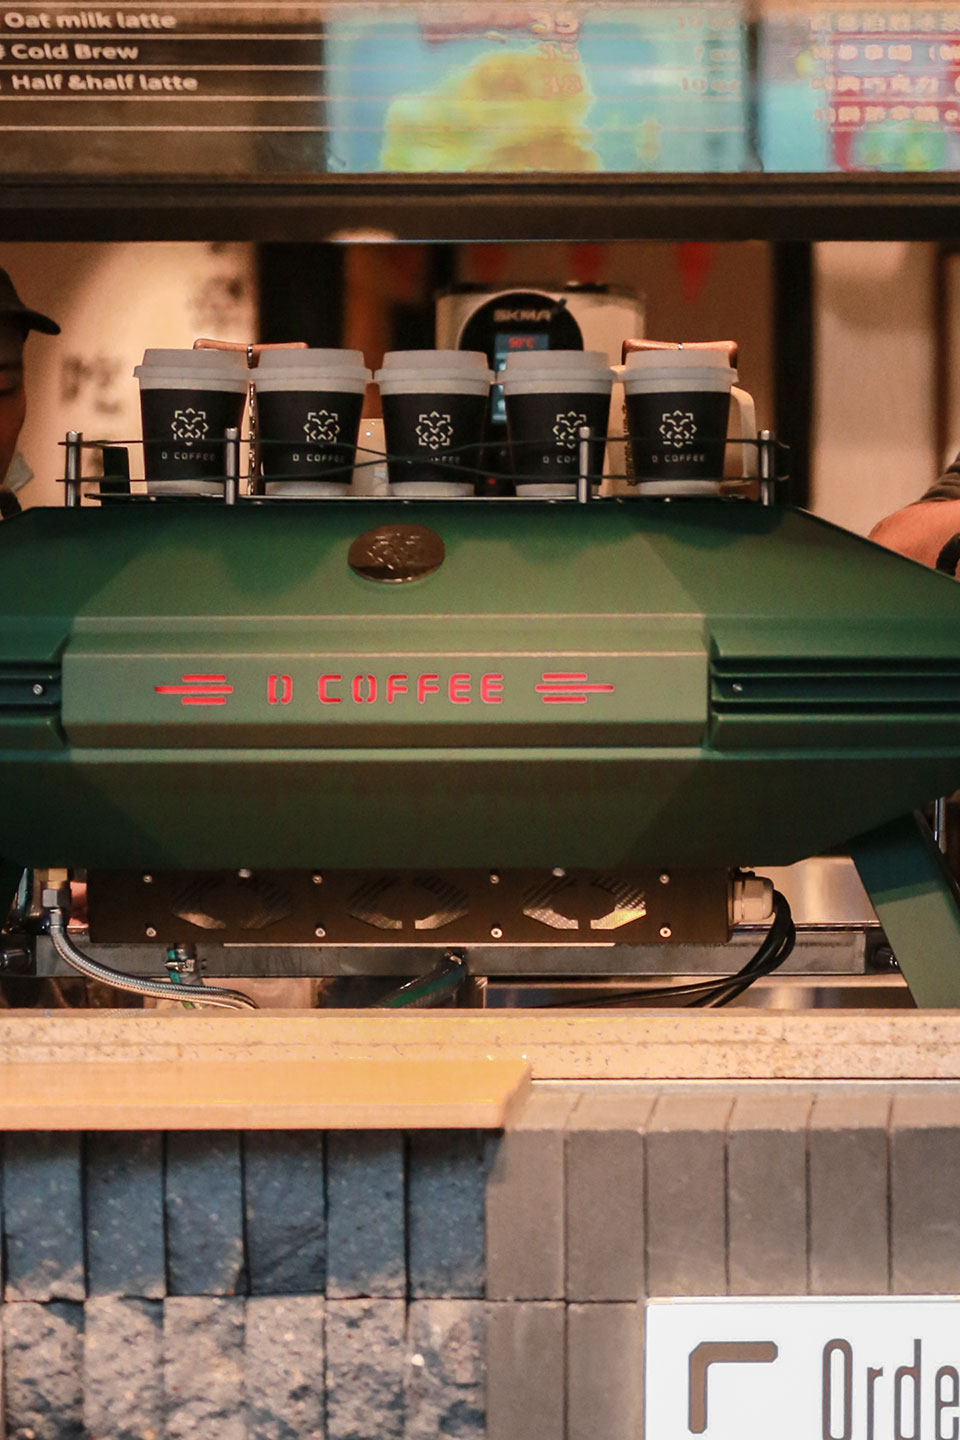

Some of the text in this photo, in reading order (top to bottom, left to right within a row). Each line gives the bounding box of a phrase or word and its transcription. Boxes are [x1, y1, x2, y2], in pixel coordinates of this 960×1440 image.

[4, 12, 177, 29] Oat milk latte
[11, 43, 69, 60] Cold
[74, 43, 139, 60] Brew
[11, 74, 63, 91] Half
[139, 74, 198, 91] latte
[174, 451, 216, 461] COFFEE
[664, 454, 705, 462] COFFEE
[267, 673, 504, 703] D COFFEE
